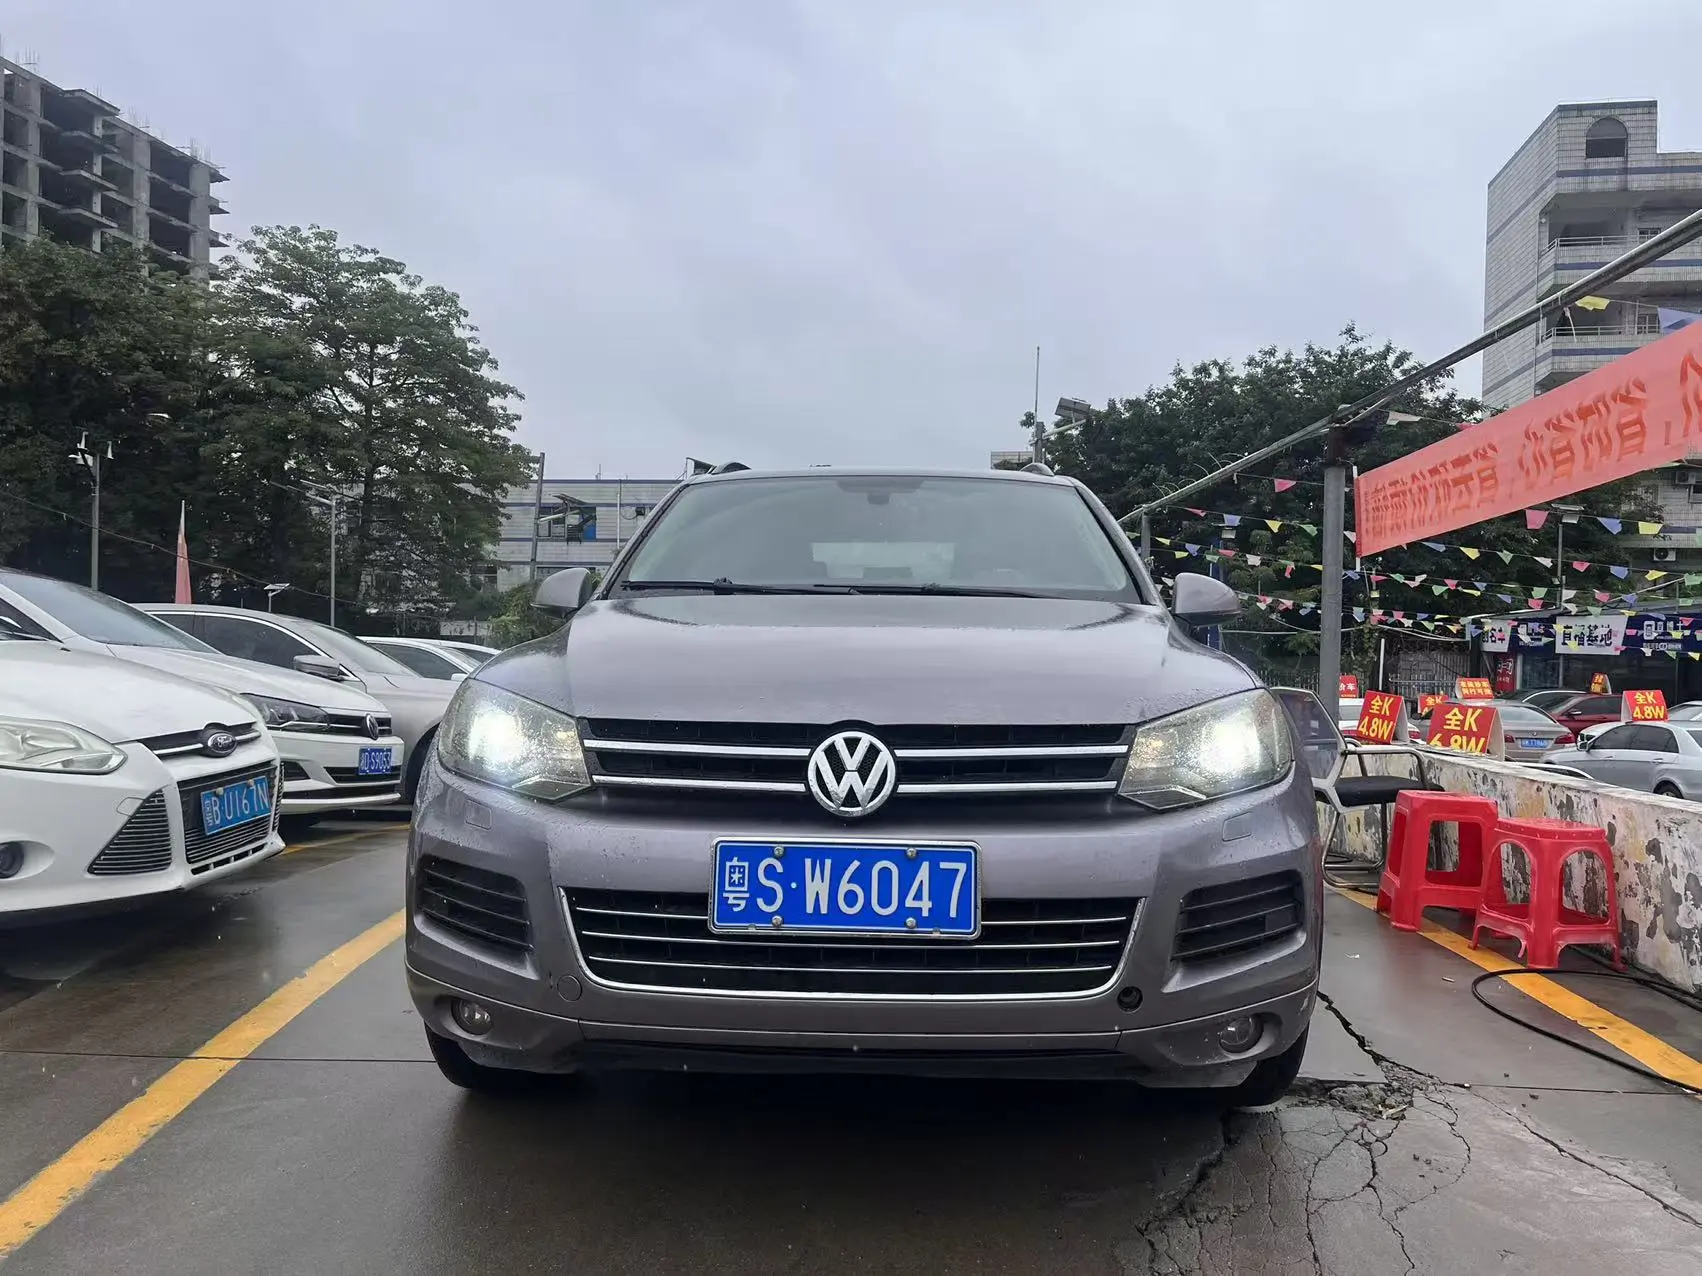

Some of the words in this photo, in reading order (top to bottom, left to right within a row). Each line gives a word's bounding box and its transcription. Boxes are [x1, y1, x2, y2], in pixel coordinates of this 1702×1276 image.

[1369, 695, 1395, 717] 全K
[1634, 691, 1657, 704] 全K
[1443, 706, 1483, 732] 全K
[1633, 705, 1665, 719] 4.8W
[1358, 715, 1394, 741] 4.8W
[1429, 732, 1486, 754] 68W
